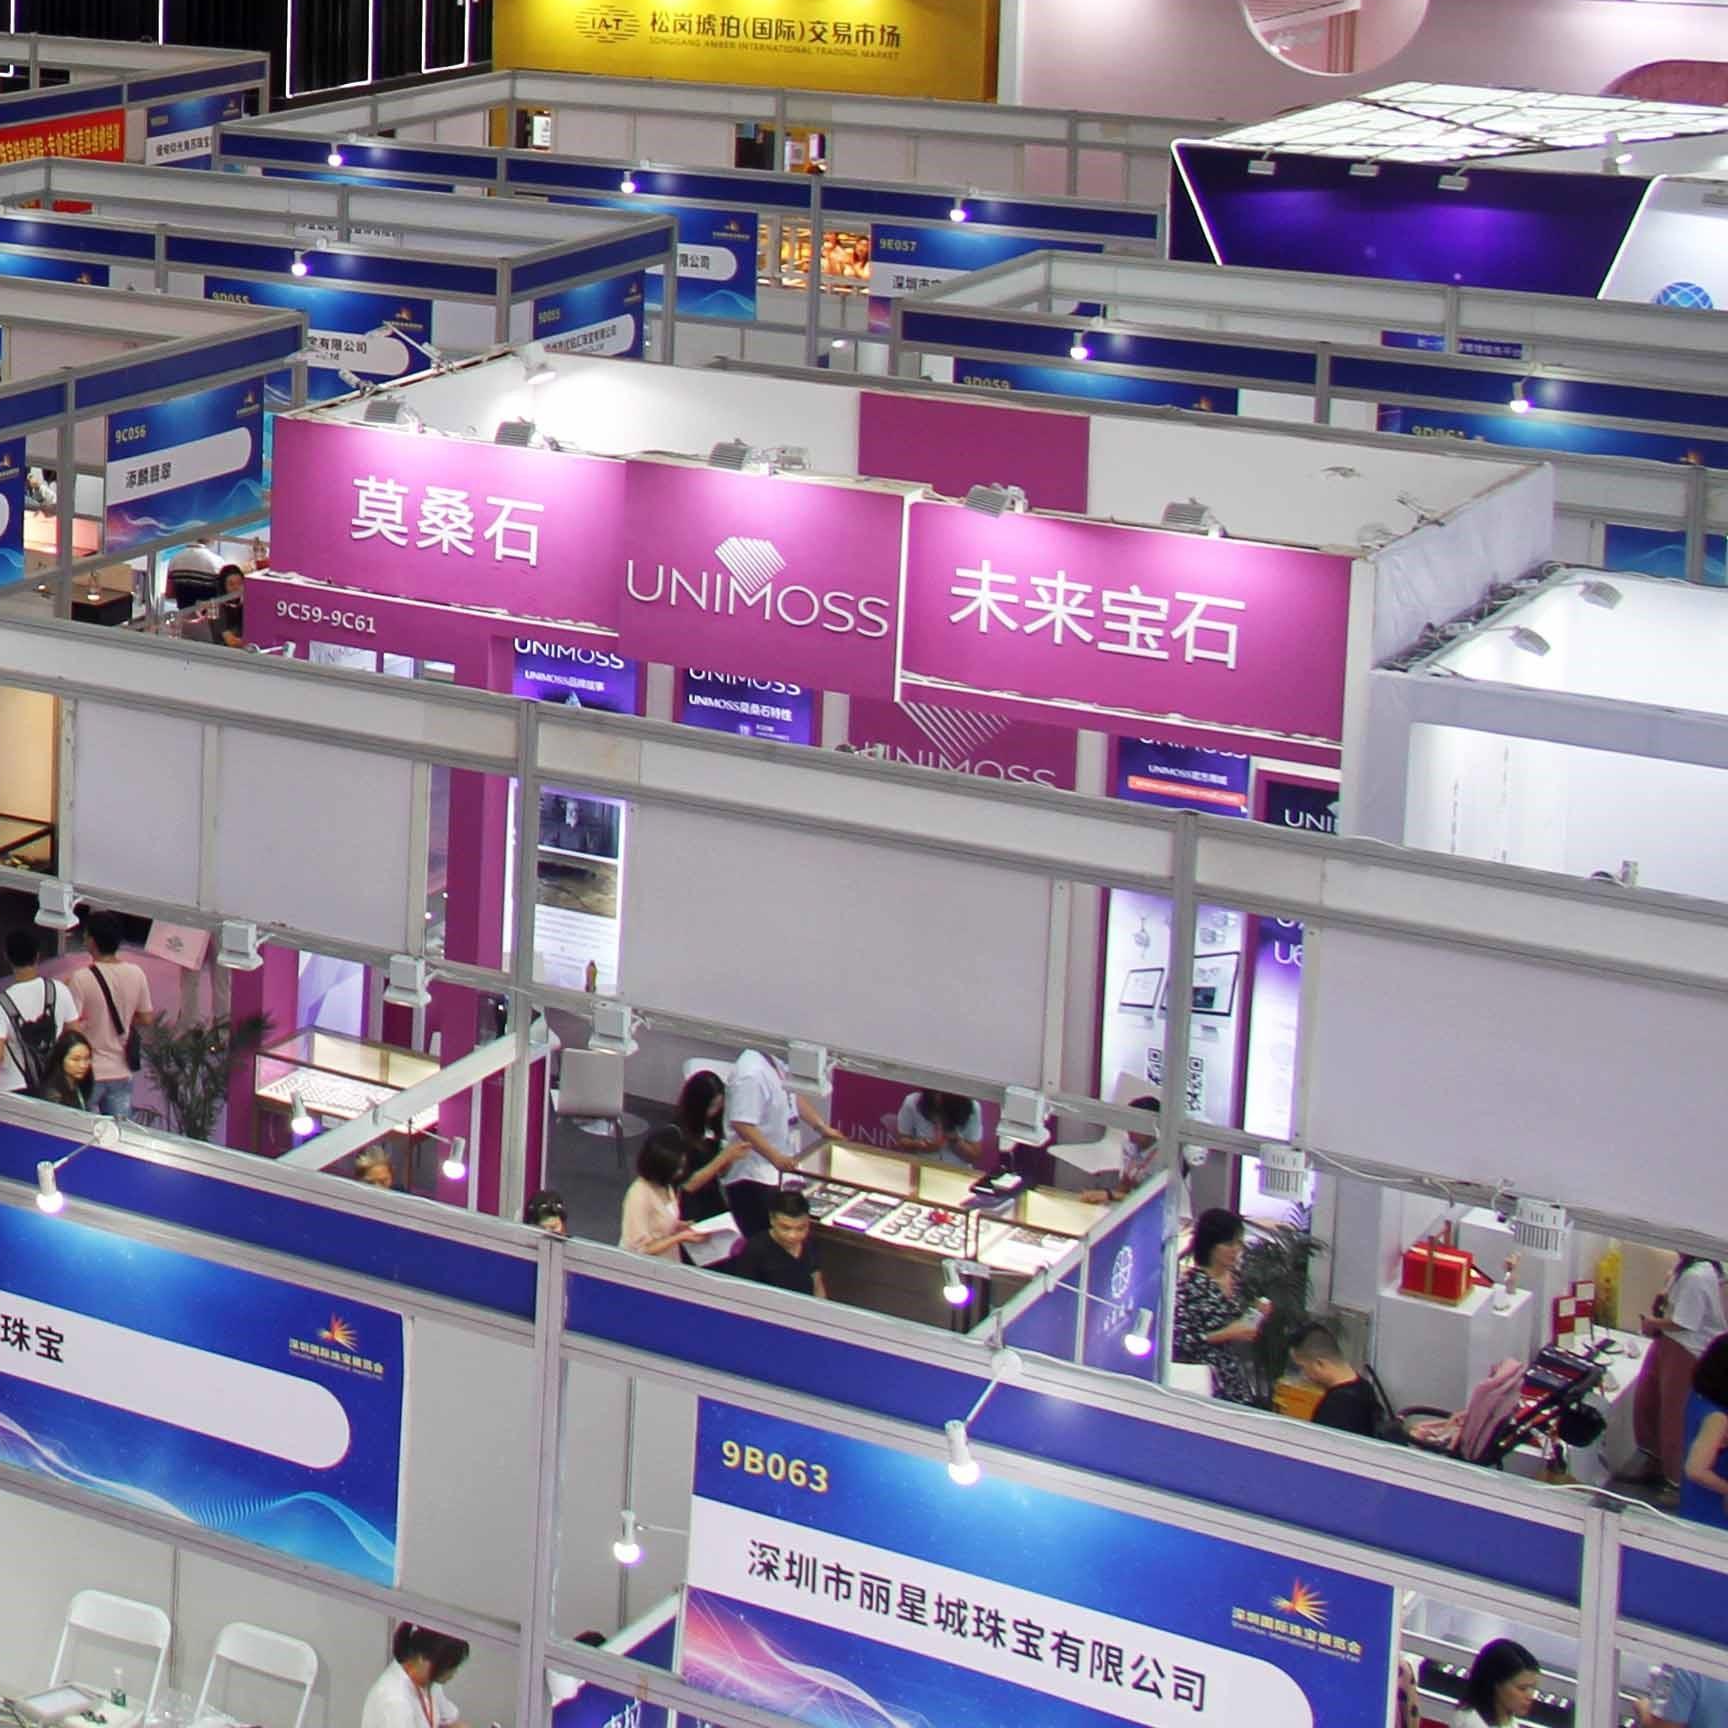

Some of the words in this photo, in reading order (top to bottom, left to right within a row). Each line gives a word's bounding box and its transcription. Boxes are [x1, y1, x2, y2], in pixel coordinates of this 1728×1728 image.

[649, 11, 902, 49] 松岗琥珀(国际)交易市场
[879, 237, 917, 252] 9E057
[349, 475, 546, 568] 莫桑石
[275, 598, 377, 635] 9C59-9C61
[627, 557, 889, 639] UNIMOSS
[948, 558, 1246, 670] 未来宝石
[513, 637, 625, 670] UNIMOSS
[1284, 808, 1339, 832] UNI
[720, 1438, 831, 1495] 9B063
[746, 1536, 1209, 1714] 深圳市丽星城珠宝有限公司
[1231, 1605, 1363, 1656] 深圳国际珠宝展览会
